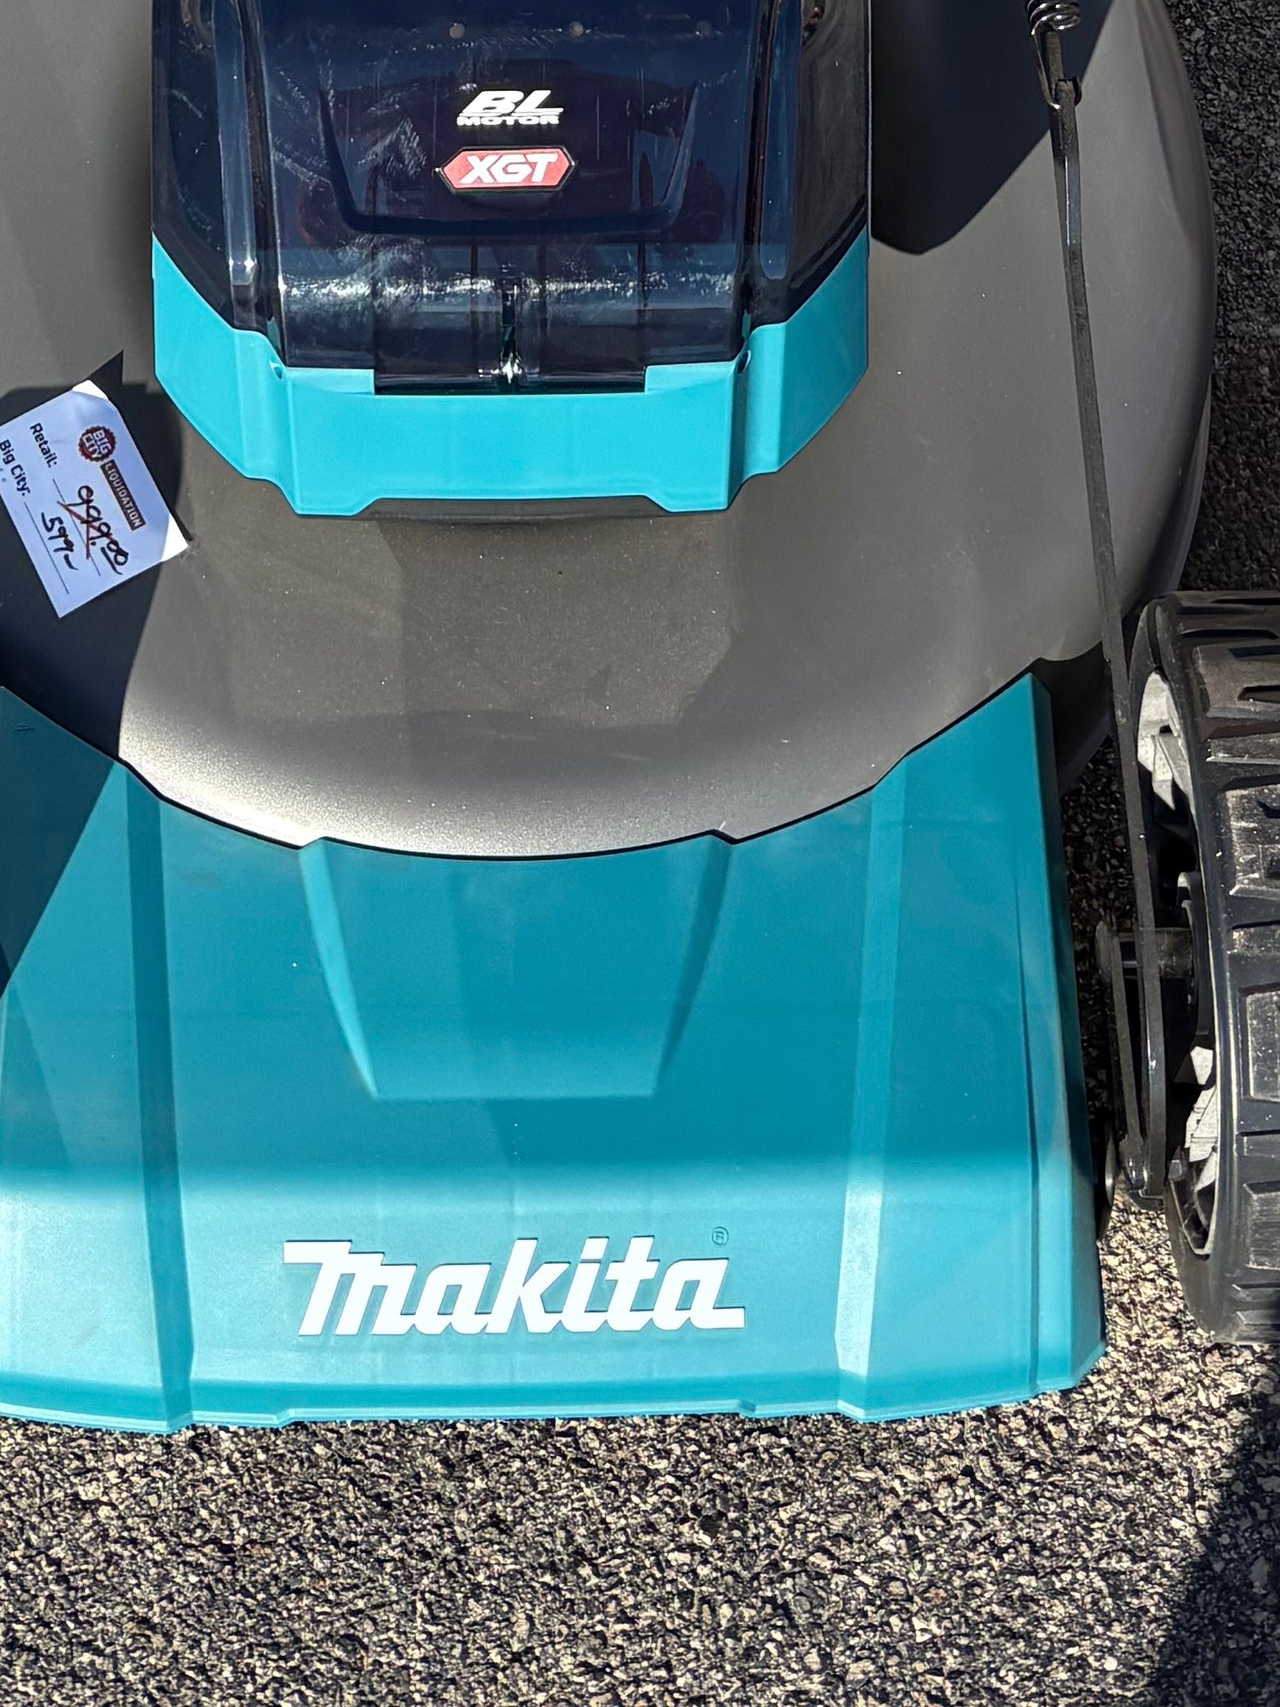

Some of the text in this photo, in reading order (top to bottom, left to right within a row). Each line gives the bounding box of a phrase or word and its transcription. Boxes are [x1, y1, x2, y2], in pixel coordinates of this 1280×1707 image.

[461, 90, 564, 116] BL
[456, 115, 560, 126] MOTOR
[459, 153, 559, 184] XGT
[30, 422, 58, 468] Retail:
[81, 434, 103, 460] CITY
[93, 429, 111, 455] BIG
[10, 464, 31, 497] City:
[104, 462, 142, 529] LIQUIDATION
[282, 1236, 746, 1336] Makita
